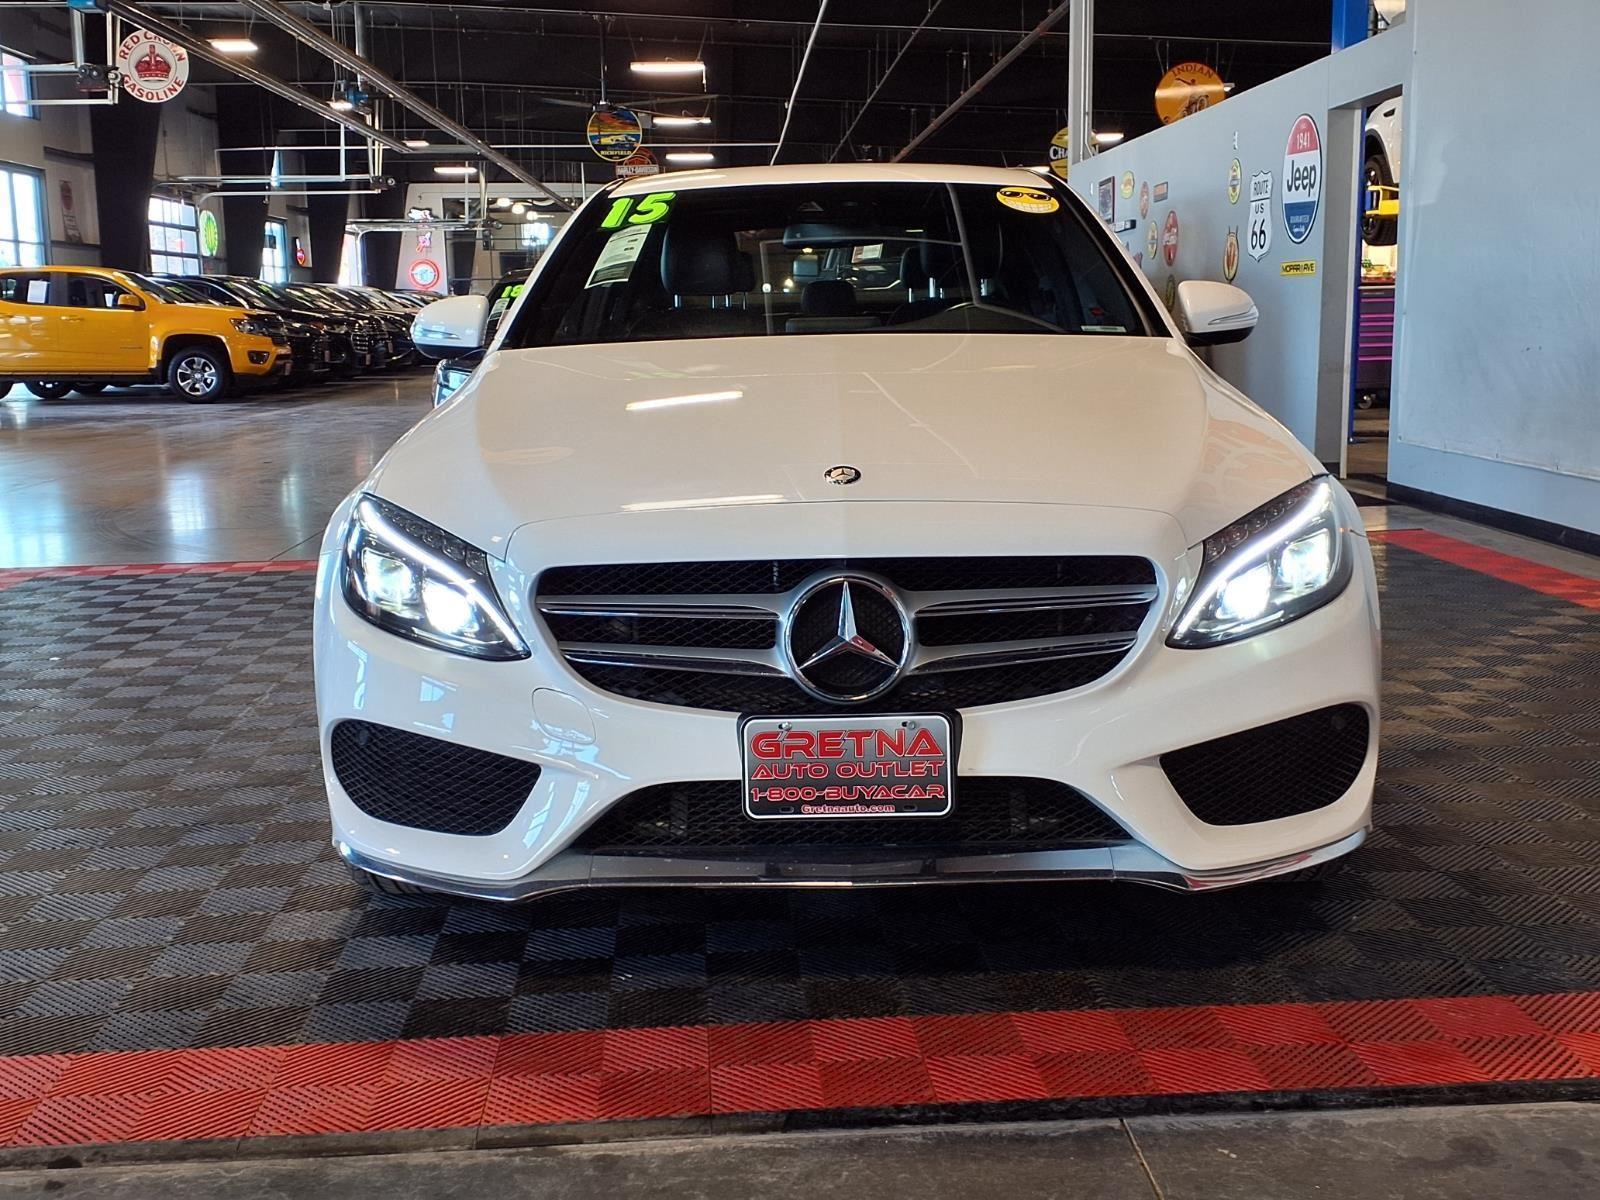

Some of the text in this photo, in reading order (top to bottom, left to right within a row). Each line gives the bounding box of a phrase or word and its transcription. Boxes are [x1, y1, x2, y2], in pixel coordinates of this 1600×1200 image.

[119, 34, 140, 60] RED
[1171, 64, 1213, 78] INDIAN
[123, 74, 184, 101] GASOLINE
[1296, 131, 1310, 150] 1941
[1253, 180, 1269, 196] ROUTE
[1287, 160, 1317, 197] Jeep
[601, 192, 676, 228] 15
[1254, 203, 1265, 214] US
[1250, 218, 1267, 250] 66
[751, 727, 944, 760] GRETNA
[751, 760, 946, 780] AUTO OUTLET
[751, 785, 946, 802] 1-800-BUYACAR
[800, 804, 896, 814] Gretnaauto.com
